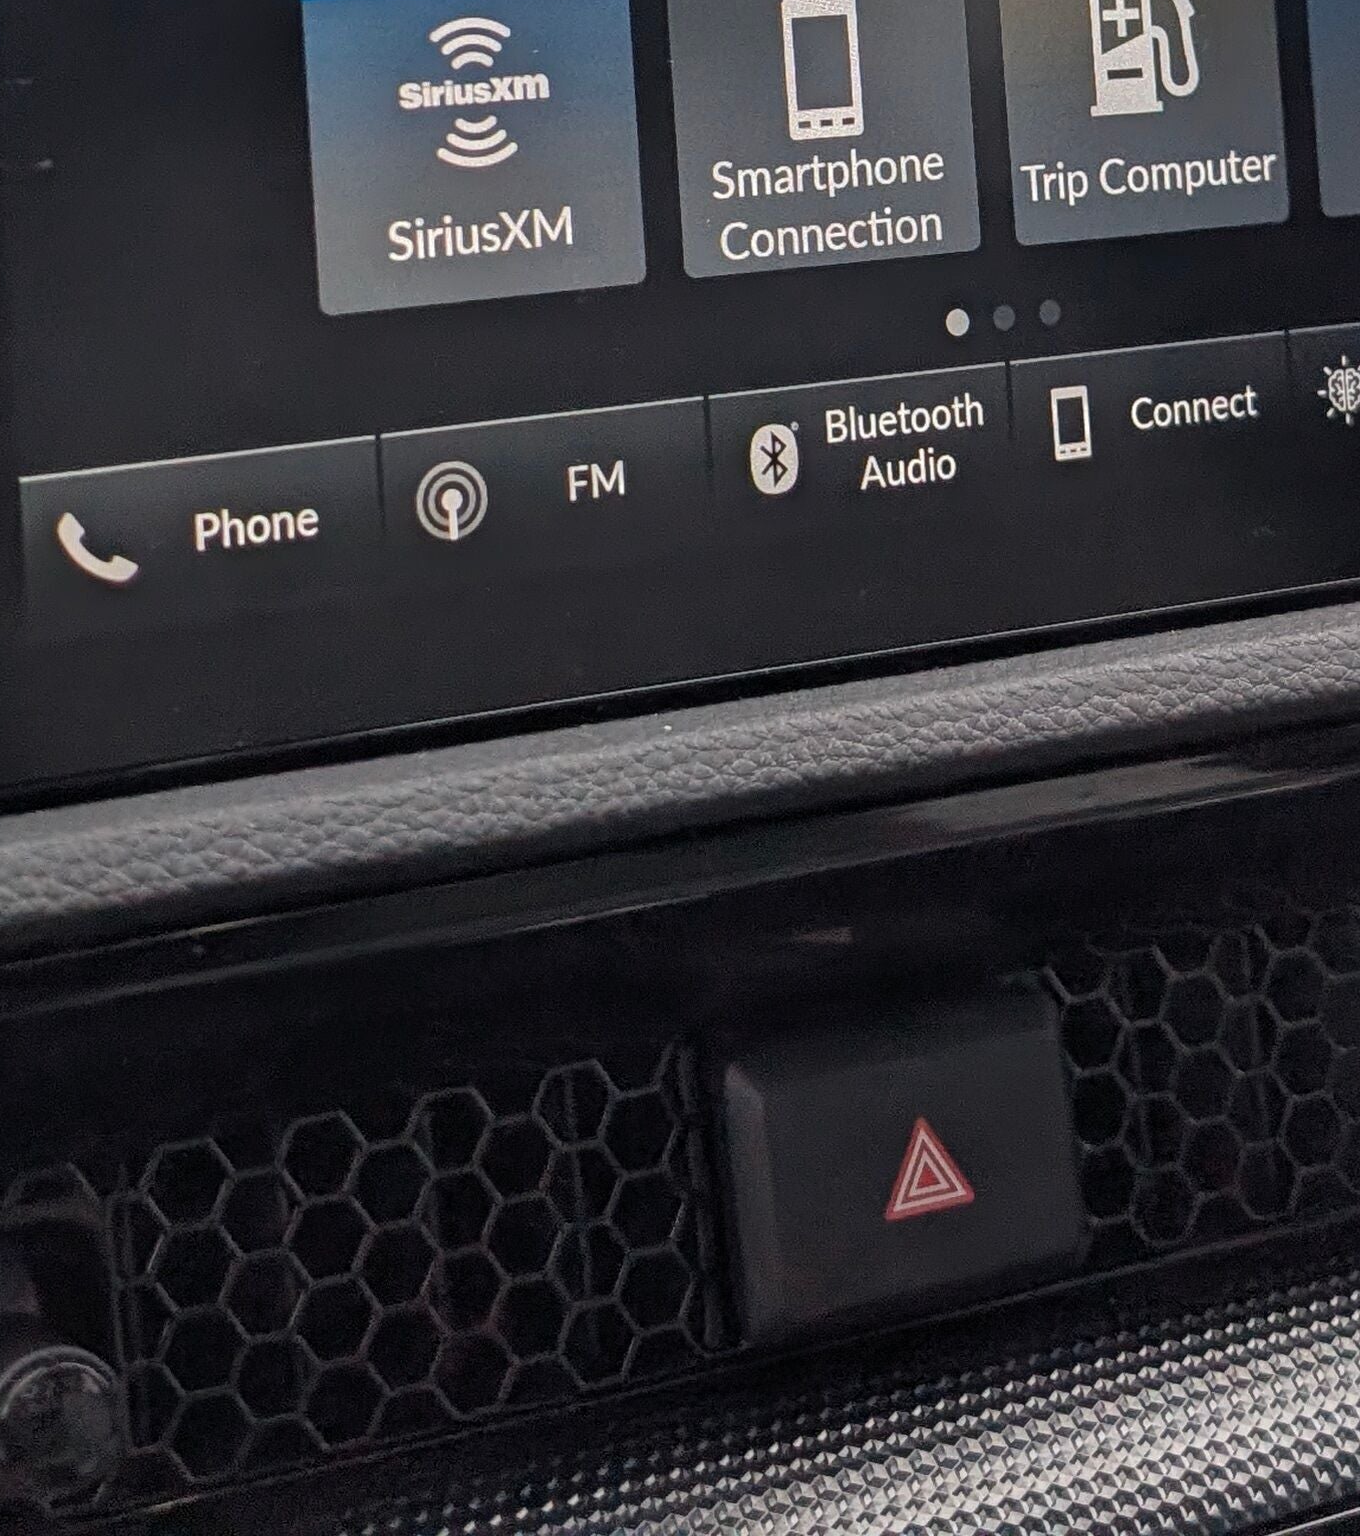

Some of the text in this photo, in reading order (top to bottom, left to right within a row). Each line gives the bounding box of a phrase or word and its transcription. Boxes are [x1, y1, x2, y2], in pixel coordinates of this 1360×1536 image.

[712, 148, 944, 200] Smartphone
[1019, 150, 1277, 206] Trip Computer
[388, 206, 574, 262] SiriusXM
[720, 206, 943, 261] Connection
[825, 393, 985, 444] Bluetooth
[1130, 384, 1258, 430] Connect
[567, 460, 625, 502] FM
[860, 446, 957, 490] Audio
[194, 505, 320, 552] Phone
